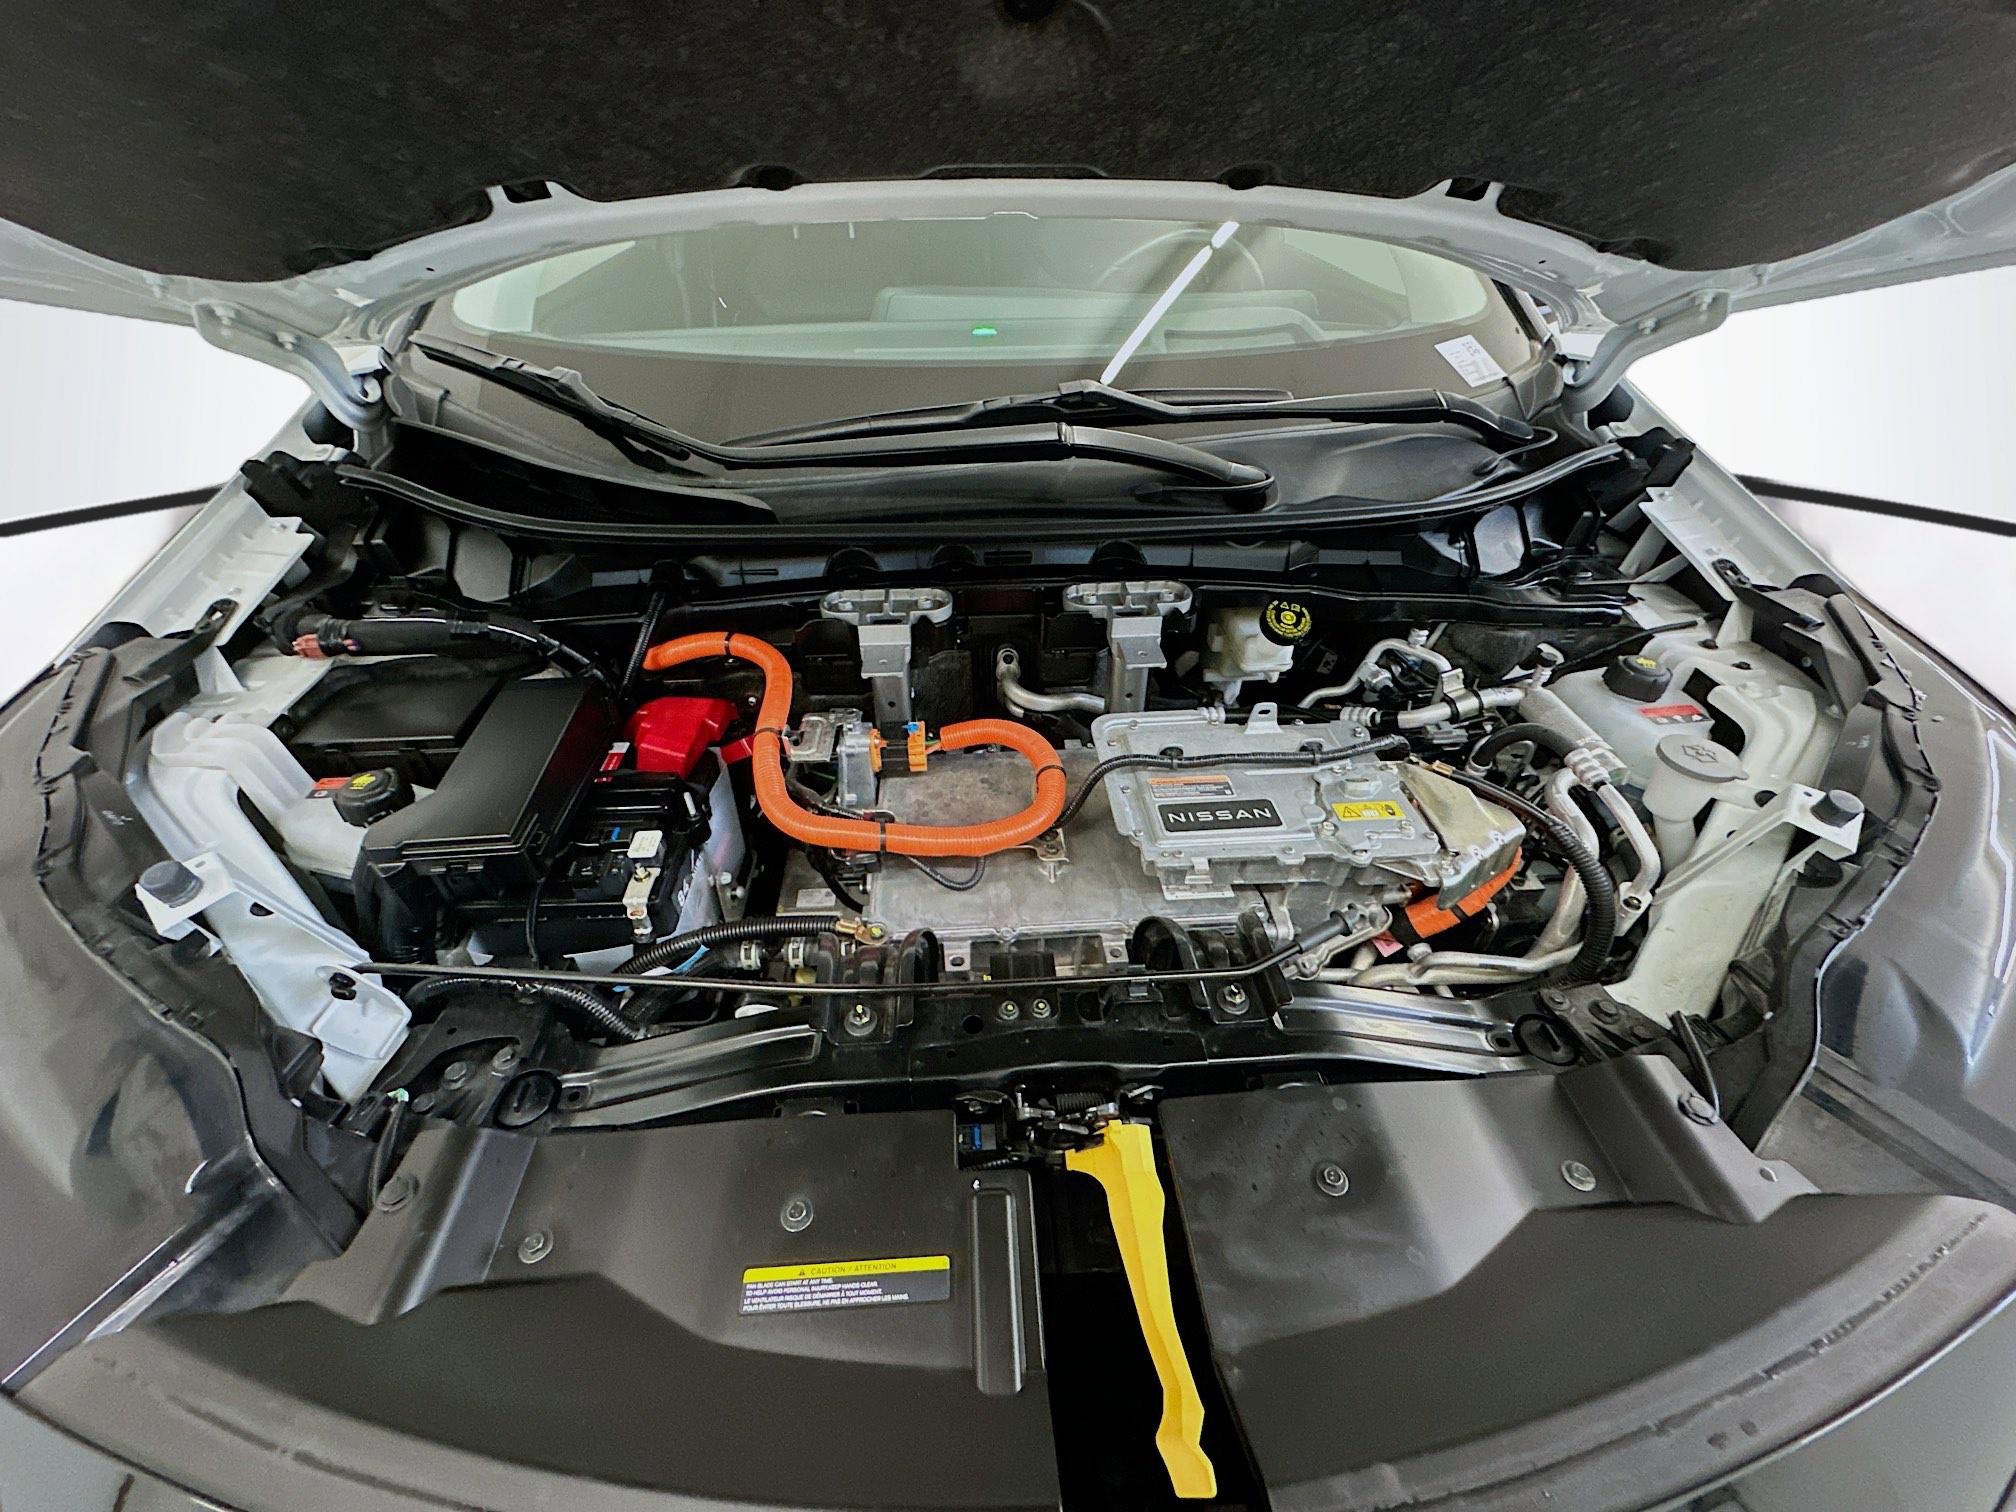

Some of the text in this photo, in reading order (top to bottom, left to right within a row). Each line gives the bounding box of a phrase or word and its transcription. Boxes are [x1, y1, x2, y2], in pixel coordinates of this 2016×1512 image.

[1168, 807, 1272, 823] NISSAN
[811, 1267, 845, 1275] CAUTION
[854, 1263, 897, 1272] ATTENTION
